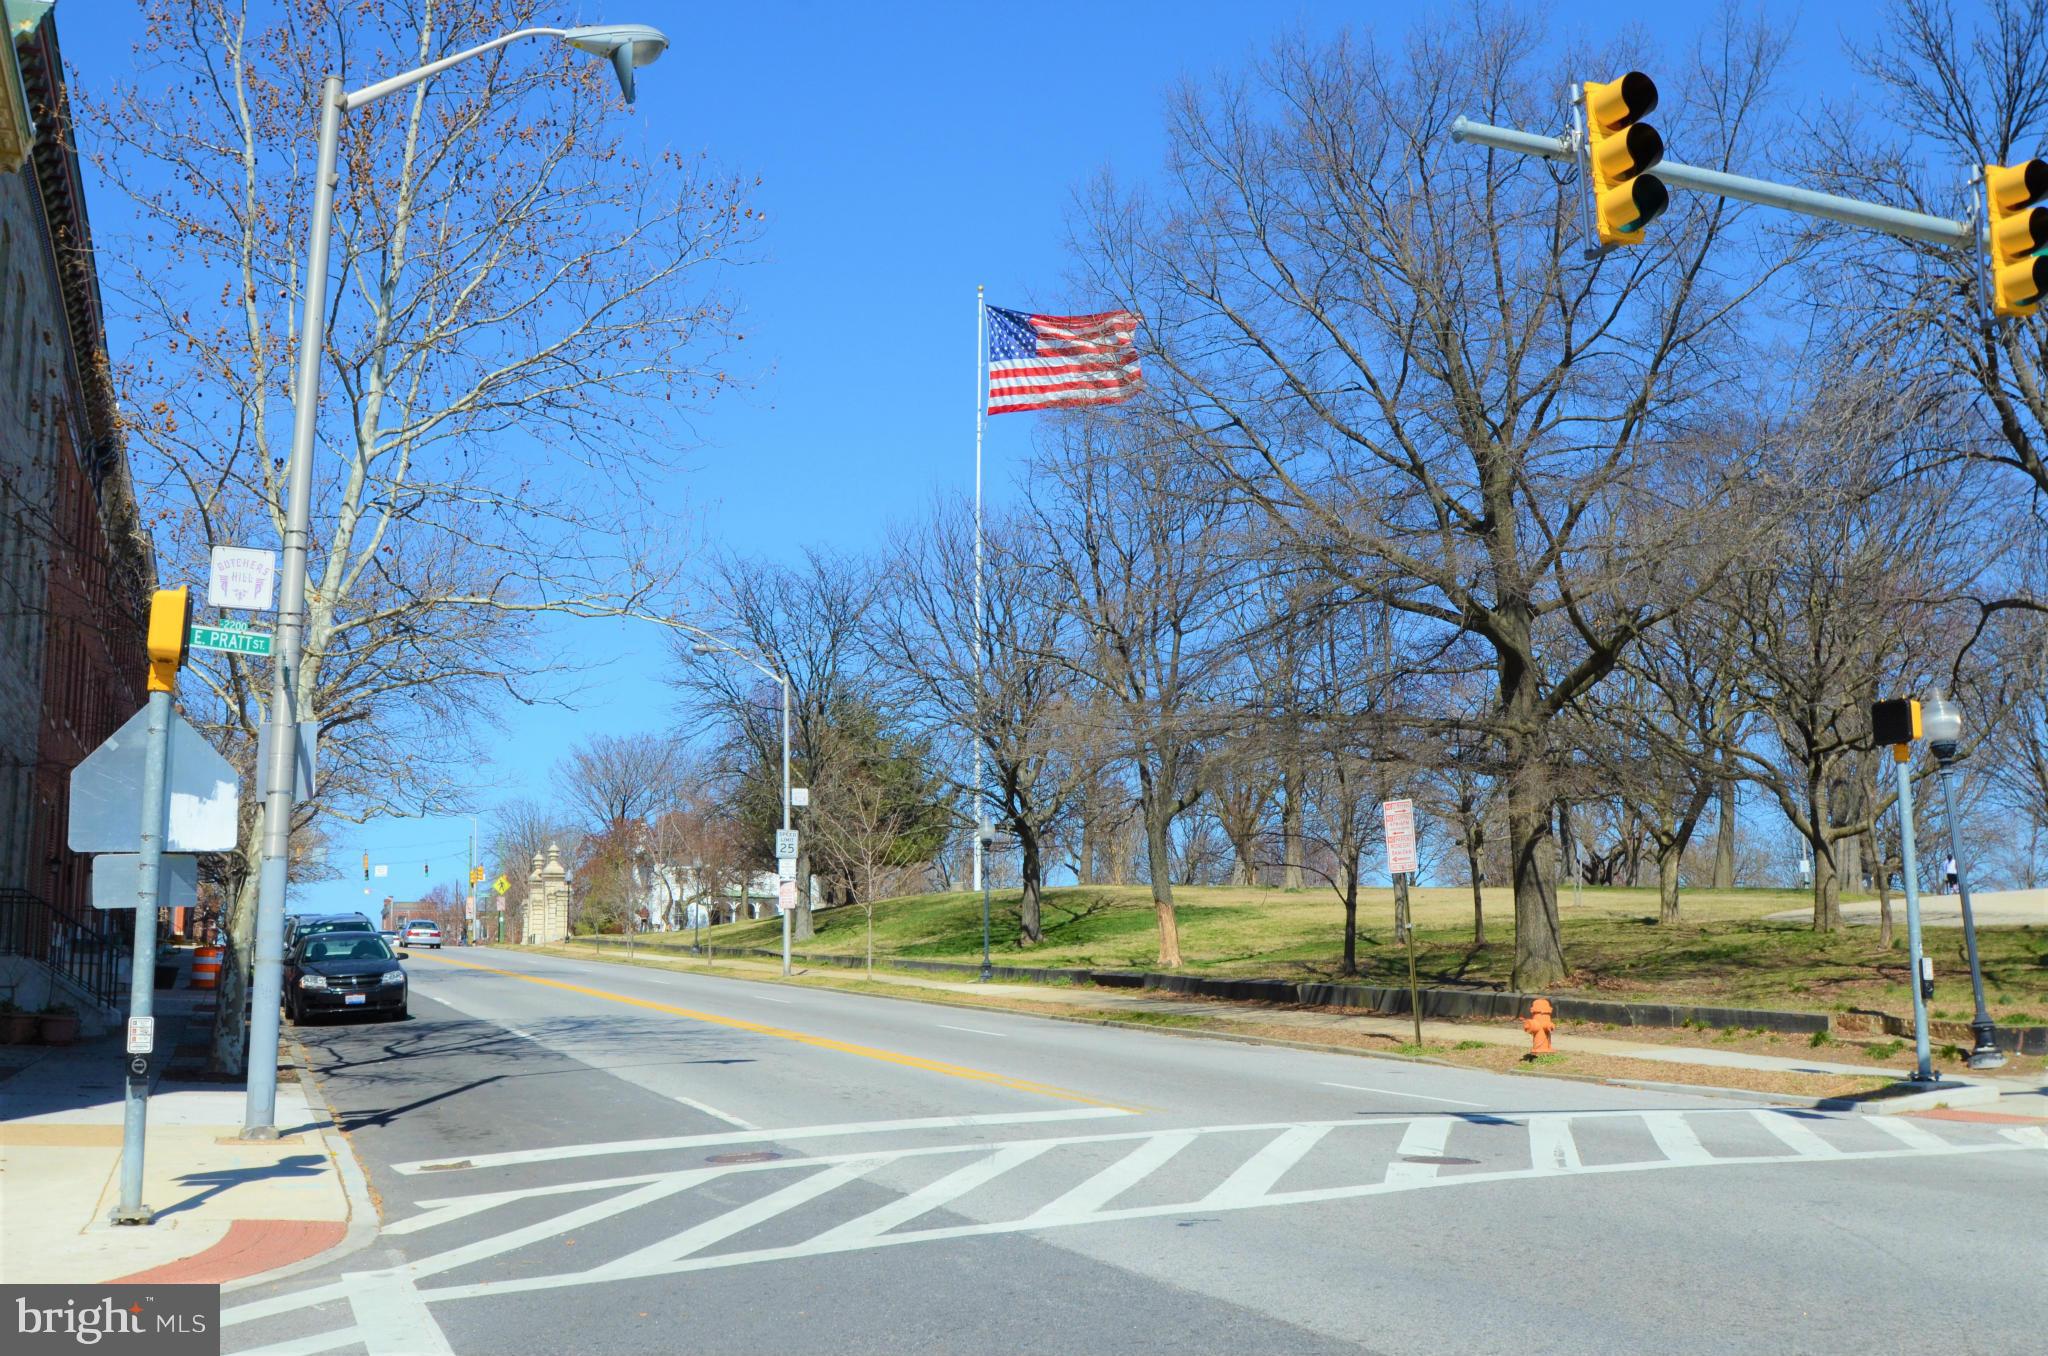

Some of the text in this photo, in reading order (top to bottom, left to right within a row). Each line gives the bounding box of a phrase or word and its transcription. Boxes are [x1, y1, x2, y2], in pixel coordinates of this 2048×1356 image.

[217, 558, 270, 576] BUTCHERS
[231, 571, 253, 583] HILL
[194, 630, 265, 650] E. PRATT ST.
[780, 843, 795, 854] 25
